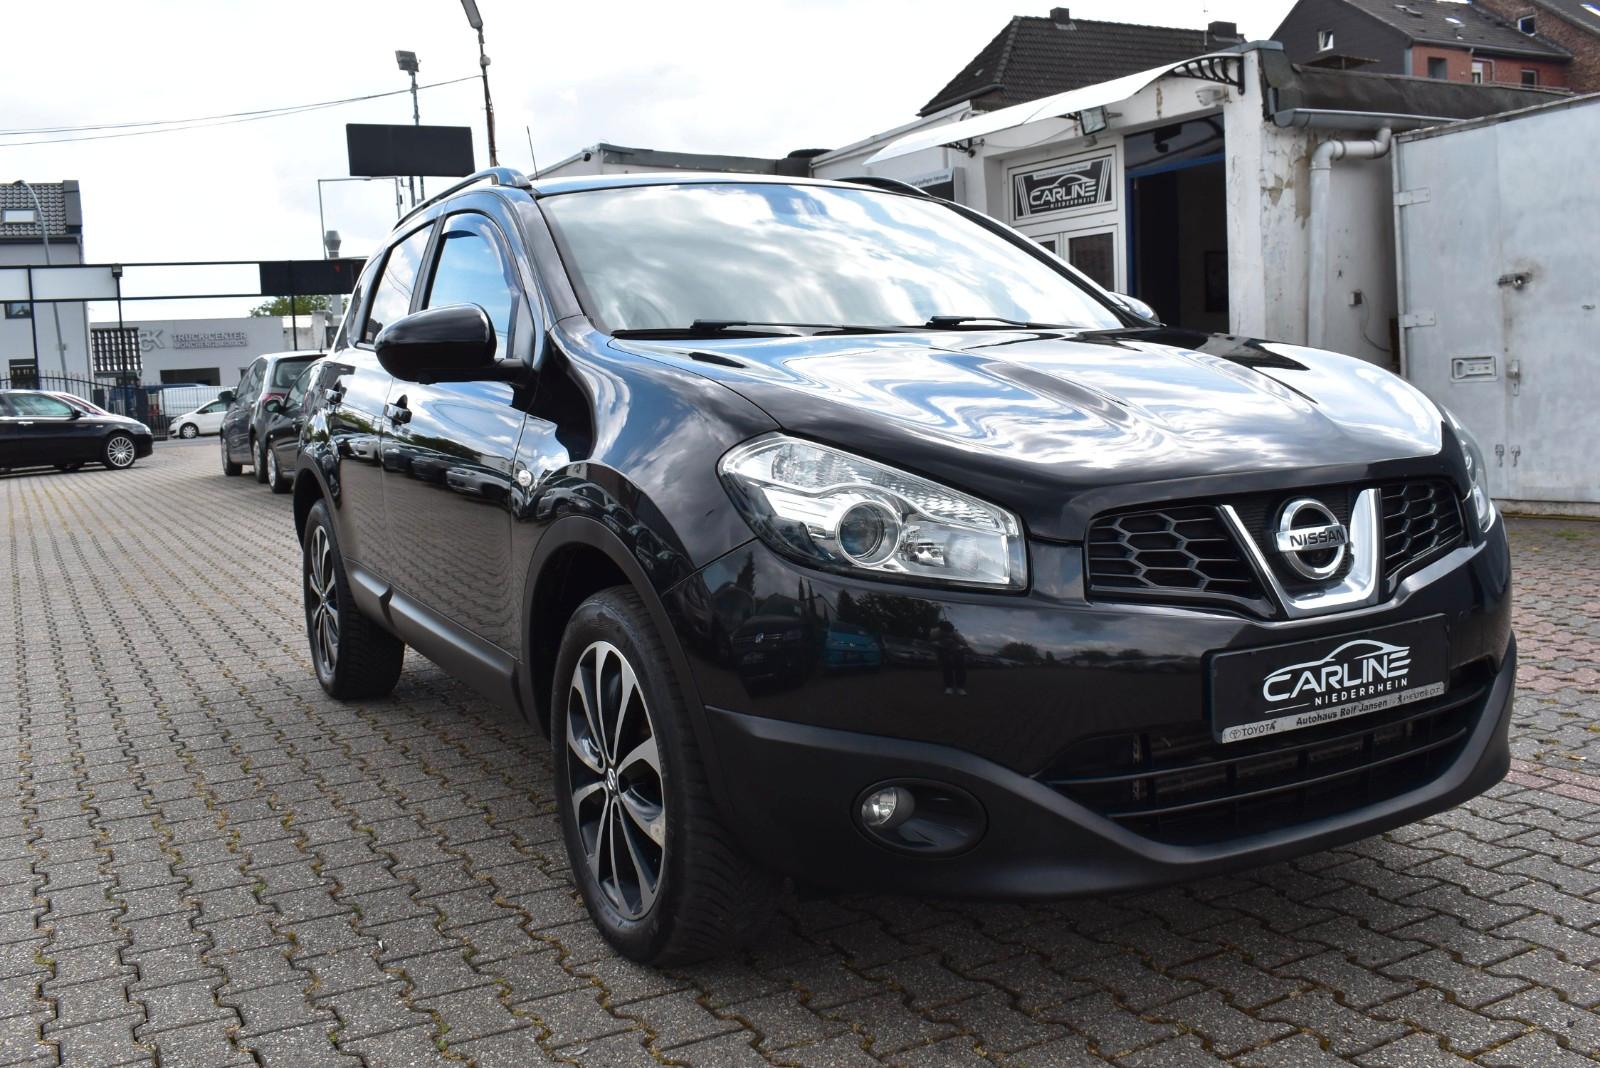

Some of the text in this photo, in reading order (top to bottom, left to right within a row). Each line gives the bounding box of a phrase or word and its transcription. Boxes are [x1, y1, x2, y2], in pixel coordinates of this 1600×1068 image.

[1030, 181, 1097, 205] CARLINE
[1289, 528, 1346, 548] NISSAN
[1263, 650, 1411, 702] CARLINE
[1315, 677, 1408, 706] NIEDERRHEIN
[1242, 723, 1275, 737] TOYOTA
[1296, 711, 1338, 727] Autohaus
[1340, 705, 1357, 717] Rolf
[1359, 699, 1388, 713] Jansen
